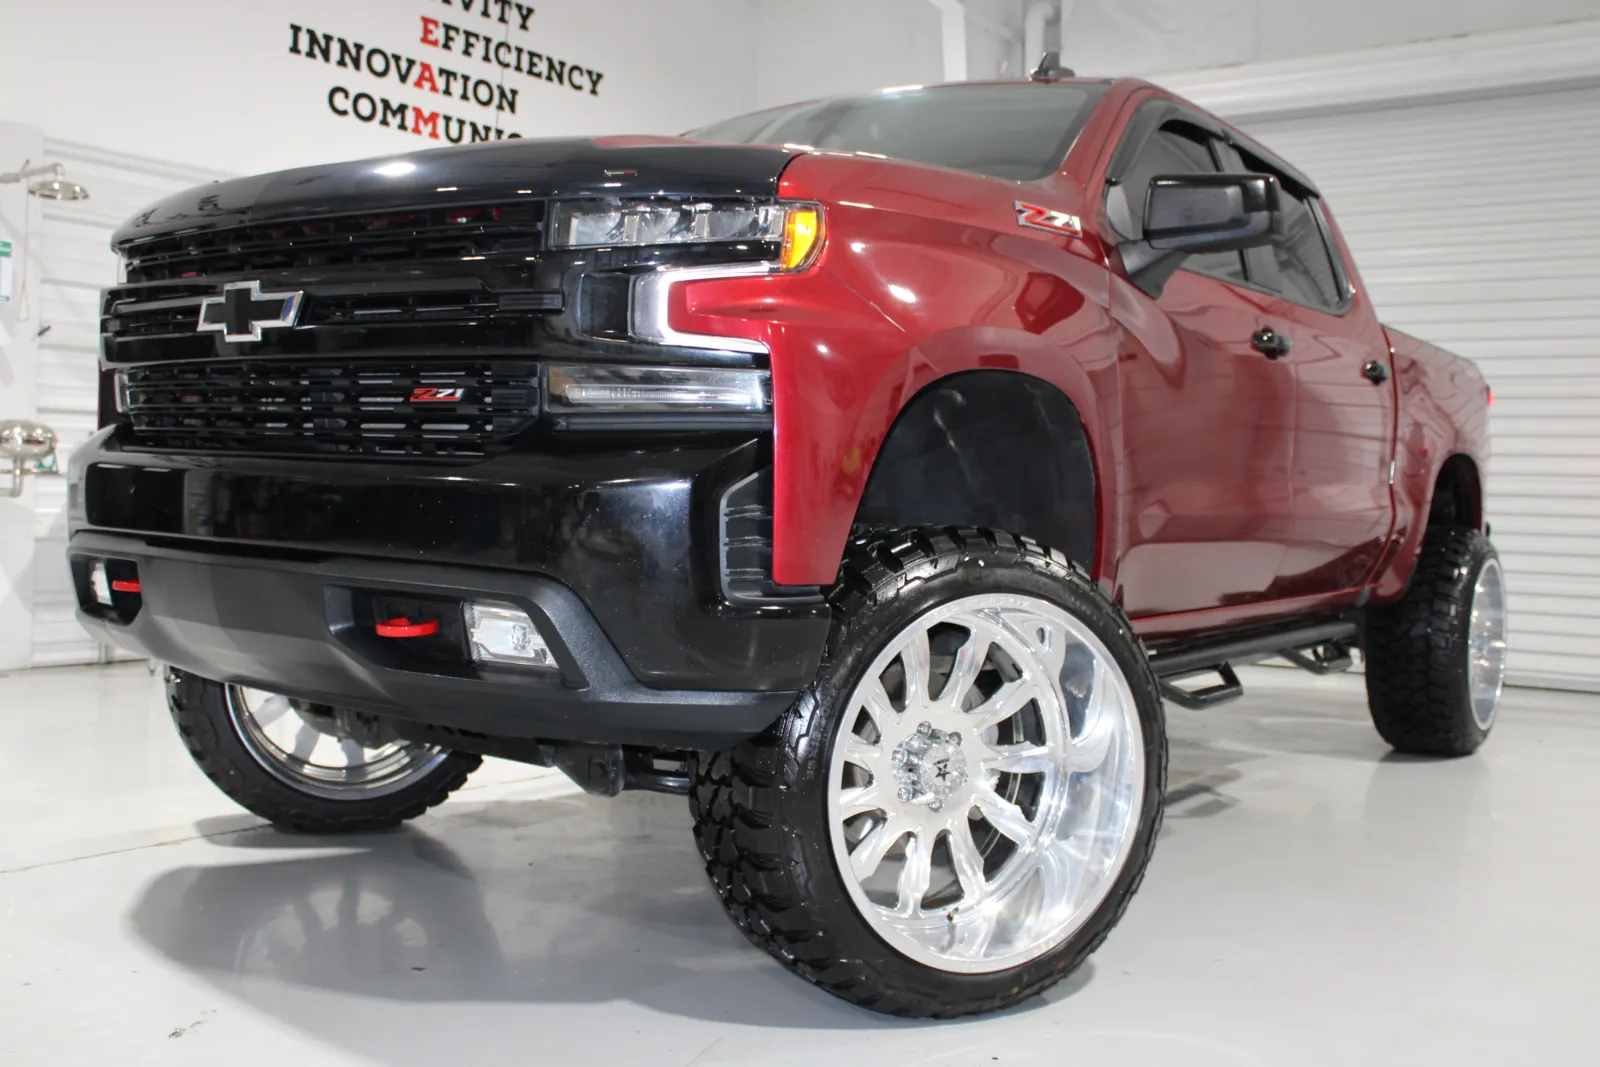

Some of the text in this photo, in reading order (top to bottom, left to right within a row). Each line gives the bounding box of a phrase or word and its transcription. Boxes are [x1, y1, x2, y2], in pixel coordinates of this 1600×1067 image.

[289, 24, 518, 115] INNOVATION
[420, 16, 604, 96] EFFICIENCY
[327, 86, 523, 145] COMMUN
[1014, 200, 1083, 238] Z71
[410, 387, 465, 402] Z71
